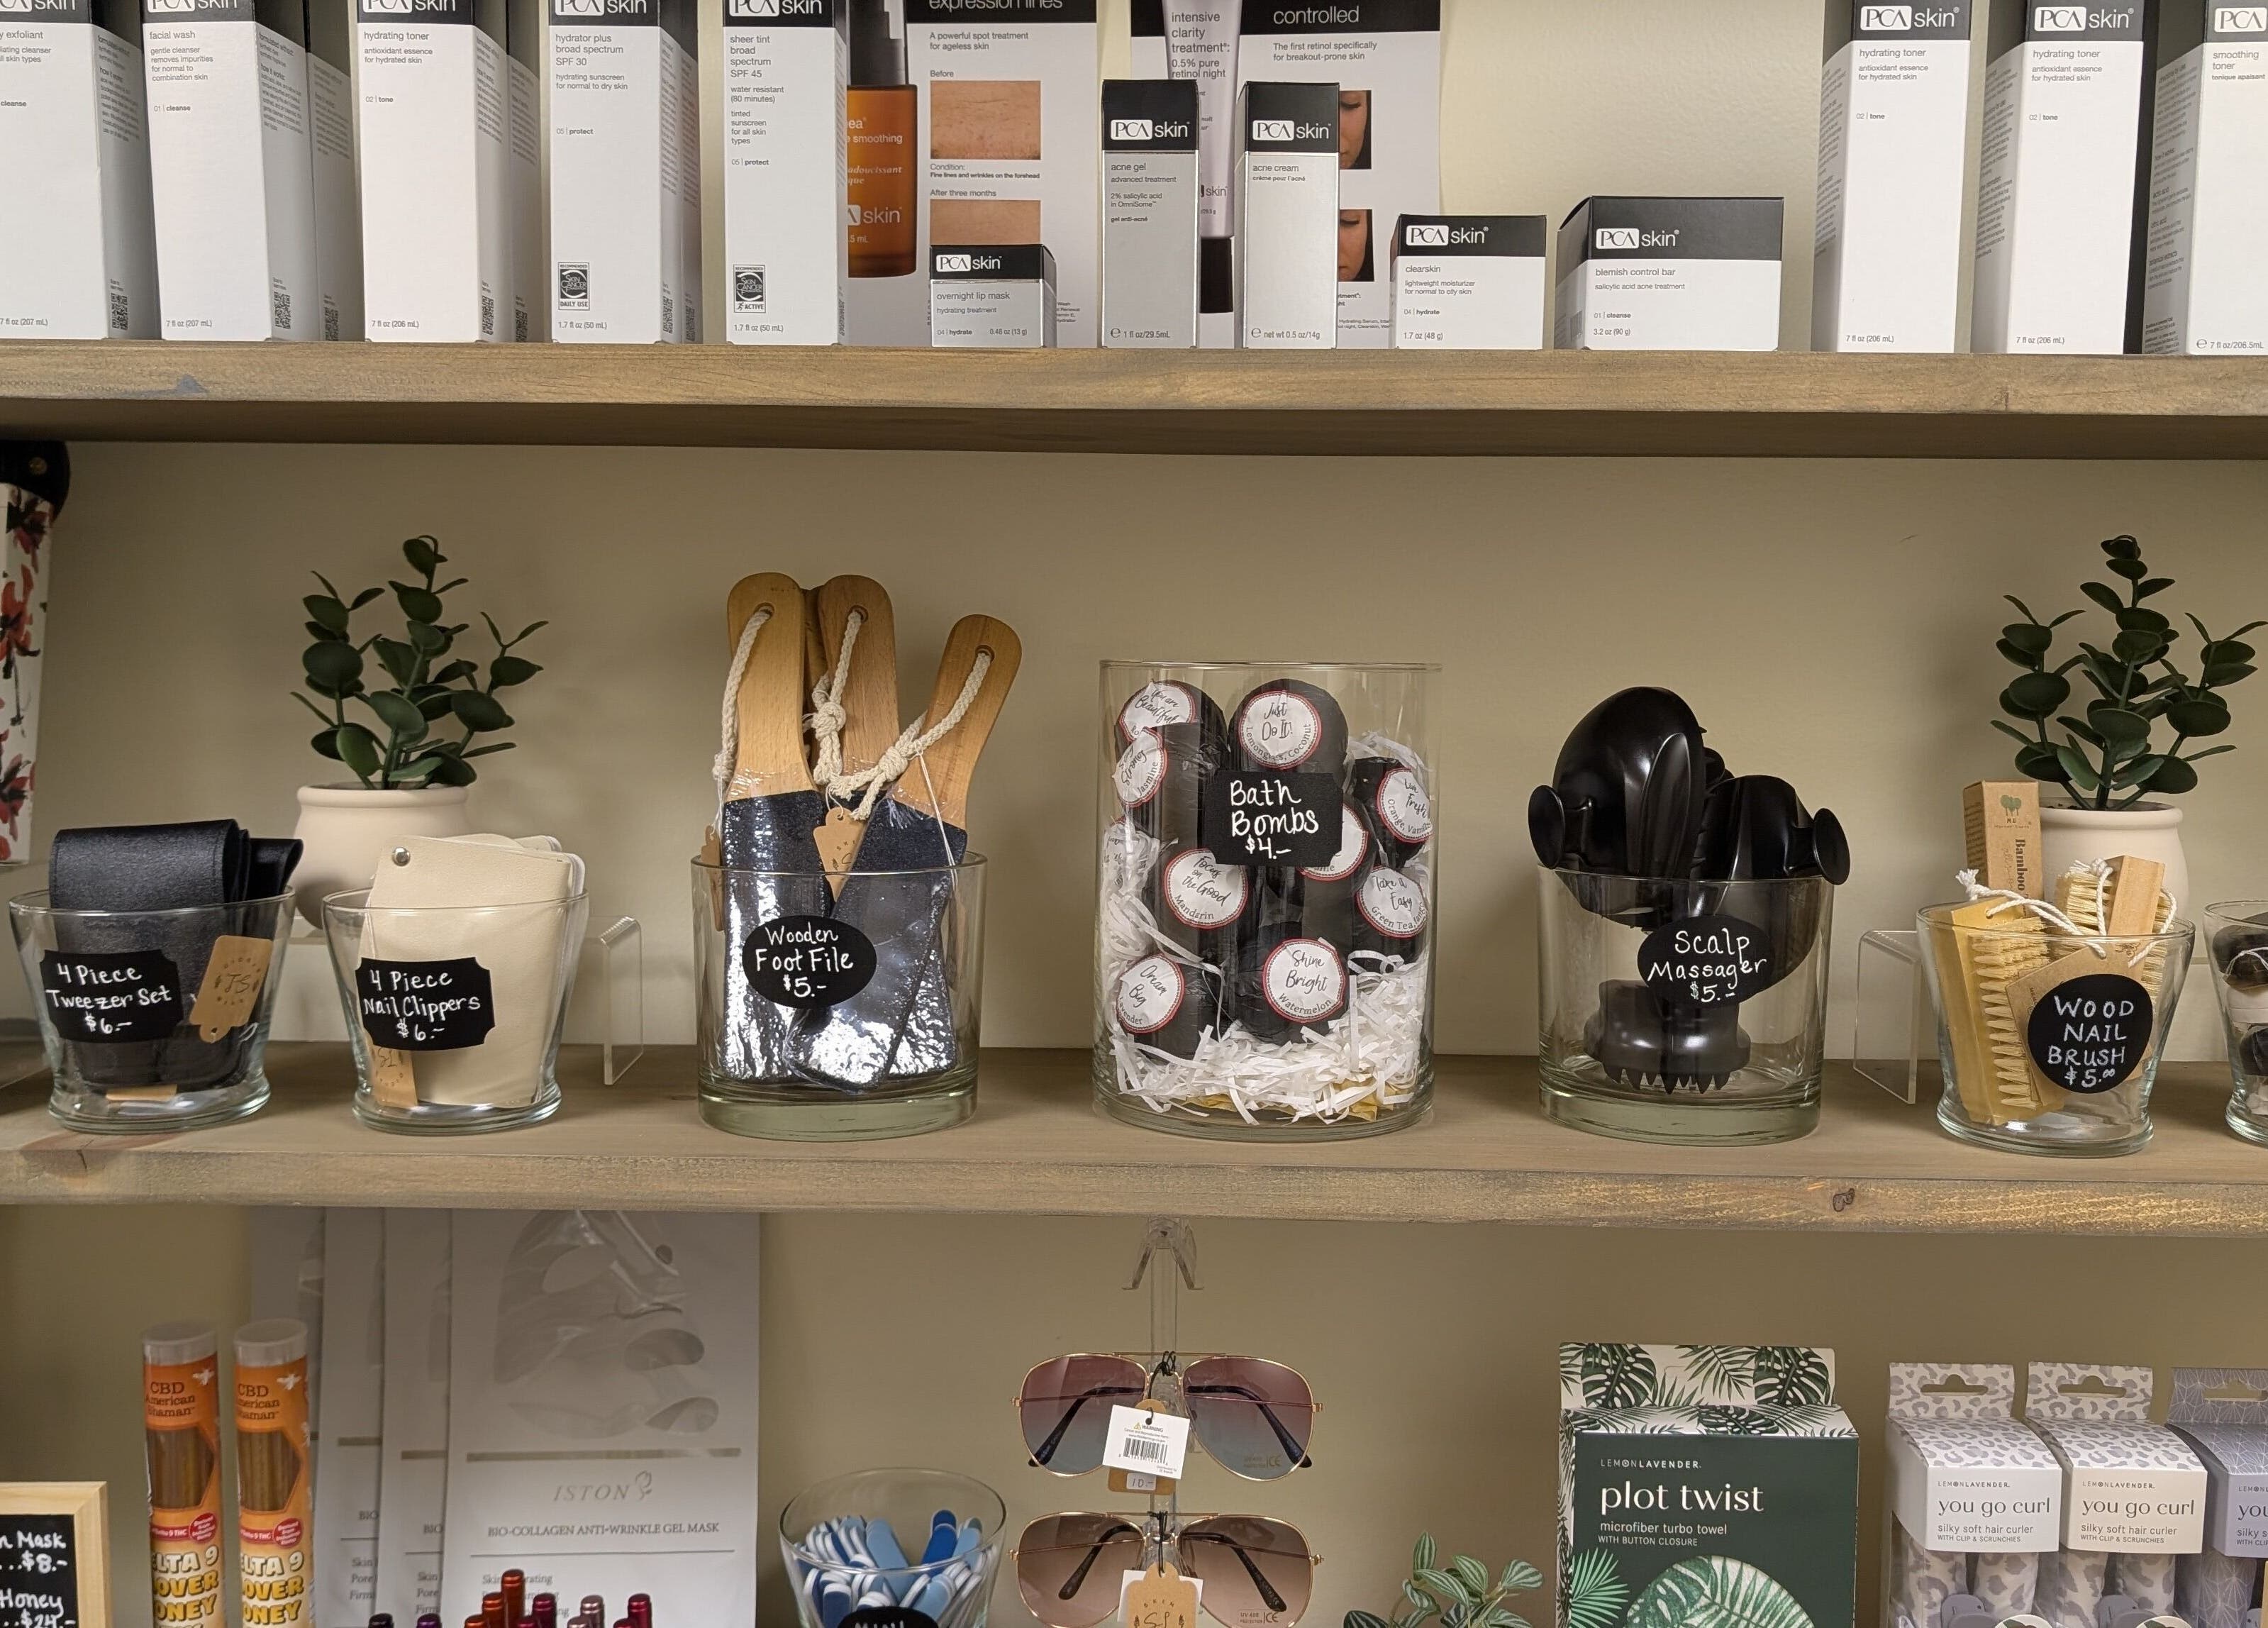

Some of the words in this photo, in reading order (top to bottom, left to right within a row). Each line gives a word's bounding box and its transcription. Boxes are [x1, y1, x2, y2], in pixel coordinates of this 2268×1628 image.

[1171, 12, 1220, 23] intensive
[1273, 6, 1359, 25] controlled
[1864, 9, 1907, 27] PCA
[6, 31, 44, 39] exfoliant
[149, 31, 170, 39] facial
[173, 31, 196, 39] wash
[364, 31, 404, 42] hydrating
[406, 32, 430, 40] toner
[555, 34, 588, 43] hydrator
[590, 34, 612, 44] plus
[937, 32, 970, 41] powerful
[972, 33, 989, 41] spot
[1171, 27, 1206, 40] clarity
[150, 46, 172, 55] gentle
[555, 45, 582, 54] broad
[584, 45, 624, 55] spectrum
[943, 43, 970, 51] ageless
[1273, 42, 1289, 50] The
[1290, 42, 1305, 50] first
[1307, 42, 1332, 50] retinol
[1333, 41, 1377, 51] specifically
[1859, 48, 1901, 59] hydrating
[1903, 49, 1927, 57] toner
[6, 55, 20, 63] skin
[22, 55, 41, 64] types
[555, 57, 574, 67] SPF
[575, 57, 587, 67] 30
[2213, 50, 2259, 61] smoothing
[730, 70, 749, 79] SPF
[751, 70, 762, 79] 45
[2213, 62, 2235, 70] toner
[730, 95, 742, 104] (80
[743, 95, 775, 104] minutes)
[1113, 122, 1150, 138] PCA
[1154, 121, 1188, 138] skin
[852, 133, 903, 145] smoothing
[1133, 162, 1147, 172] gel
[1600, 230, 1636, 247] PCA
[1404, 265, 1441, 274] clearskin
[1595, 267, 1628, 277] blemish
[1630, 267, 1659, 277] control
[1661, 267, 1676, 277] bar
[936, 292, 974, 301] overnight
[976, 292, 986, 301] lip
[186, 319, 199, 328] (207
[200, 319, 212, 328] mL)
[1264, 702, 1287, 719] Just
[1262, 721, 1277, 741] Do
[1288, 724, 1312, 758] Coconut
[1138, 760, 1158, 797] Jasmine
[1230, 780, 1301, 807] Bath
[1231, 808, 1319, 837] Bombs
[1192, 856, 1222, 878] Focus
[2016, 839, 2028, 891] Bamboo
[1182, 875, 1198, 891] the
[1197, 879, 1232, 907] Good
[1174, 894, 1214, 921] Mandarin
[765, 921, 839, 945] Wooden
[1674, 927, 1750, 963] Scalp
[756, 949, 804, 972] Foot
[809, 946, 854, 972] File
[1291, 949, 1324, 968] Shine
[57, 963, 71, 983] 4
[76, 965, 142, 986] Piece
[369, 970, 382, 991] 4
[391, 971, 452, 991] Piece
[1140, 965, 1167, 997] Dream
[1286, 969, 1329, 992] Bright
[1647, 958, 1767, 990] Massager
[45, 989, 133, 1010] Tweezer
[138, 985, 172, 1006] Set
[1129, 985, 1147, 1008] Big
[1278, 992, 1333, 1015] Watermelon
[364, 997, 399, 1017] Nail
[402, 995, 481, 1022] Clippers
[2054, 995, 2135, 1017] WOOD
[2064, 1023, 2128, 1042] NAIL
[2047, 1046, 2125, 1066] BRUSH
[150, 1381, 185, 1394] CBD
[238, 1384, 269, 1397] CBD
[553, 1484, 630, 1502] ISTON
[1601, 1481, 1669, 1515] plot
[1680, 1483, 1764, 1512] twist
[1938, 1500, 1974, 1517] you
[1981, 1501, 2006, 1518] go
[2013, 1498, 2050, 1514] curl
[2081, 1500, 2119, 1518] you
[2125, 1502, 2151, 1519] go
[2157, 1500, 2195, 1515] curl
[577, 1524, 661, 1536] ANTI-WRINKLE
[662, 1524, 685, 1534] GEL
[687, 1522, 720, 1534] MASK
[1600, 1522, 1660, 1534] microfiber
[1663, 1523, 1693, 1534] turbo
[1697, 1524, 1727, 1535] towel
[1938, 1524, 1960, 1534] silky
[1962, 1524, 1982, 1534] soft
[1985, 1524, 2004, 1534] hair
[2006, 1524, 2034, 1534] curler
[17, 1531, 66, 1549] Mask
[1598, 1536, 1619, 1544] WITH
[1622, 1536, 1656, 1545] BUTTON
[1658, 1537, 1698, 1546] CLOSURE
[0, 1589, 63, 1619] Honey
